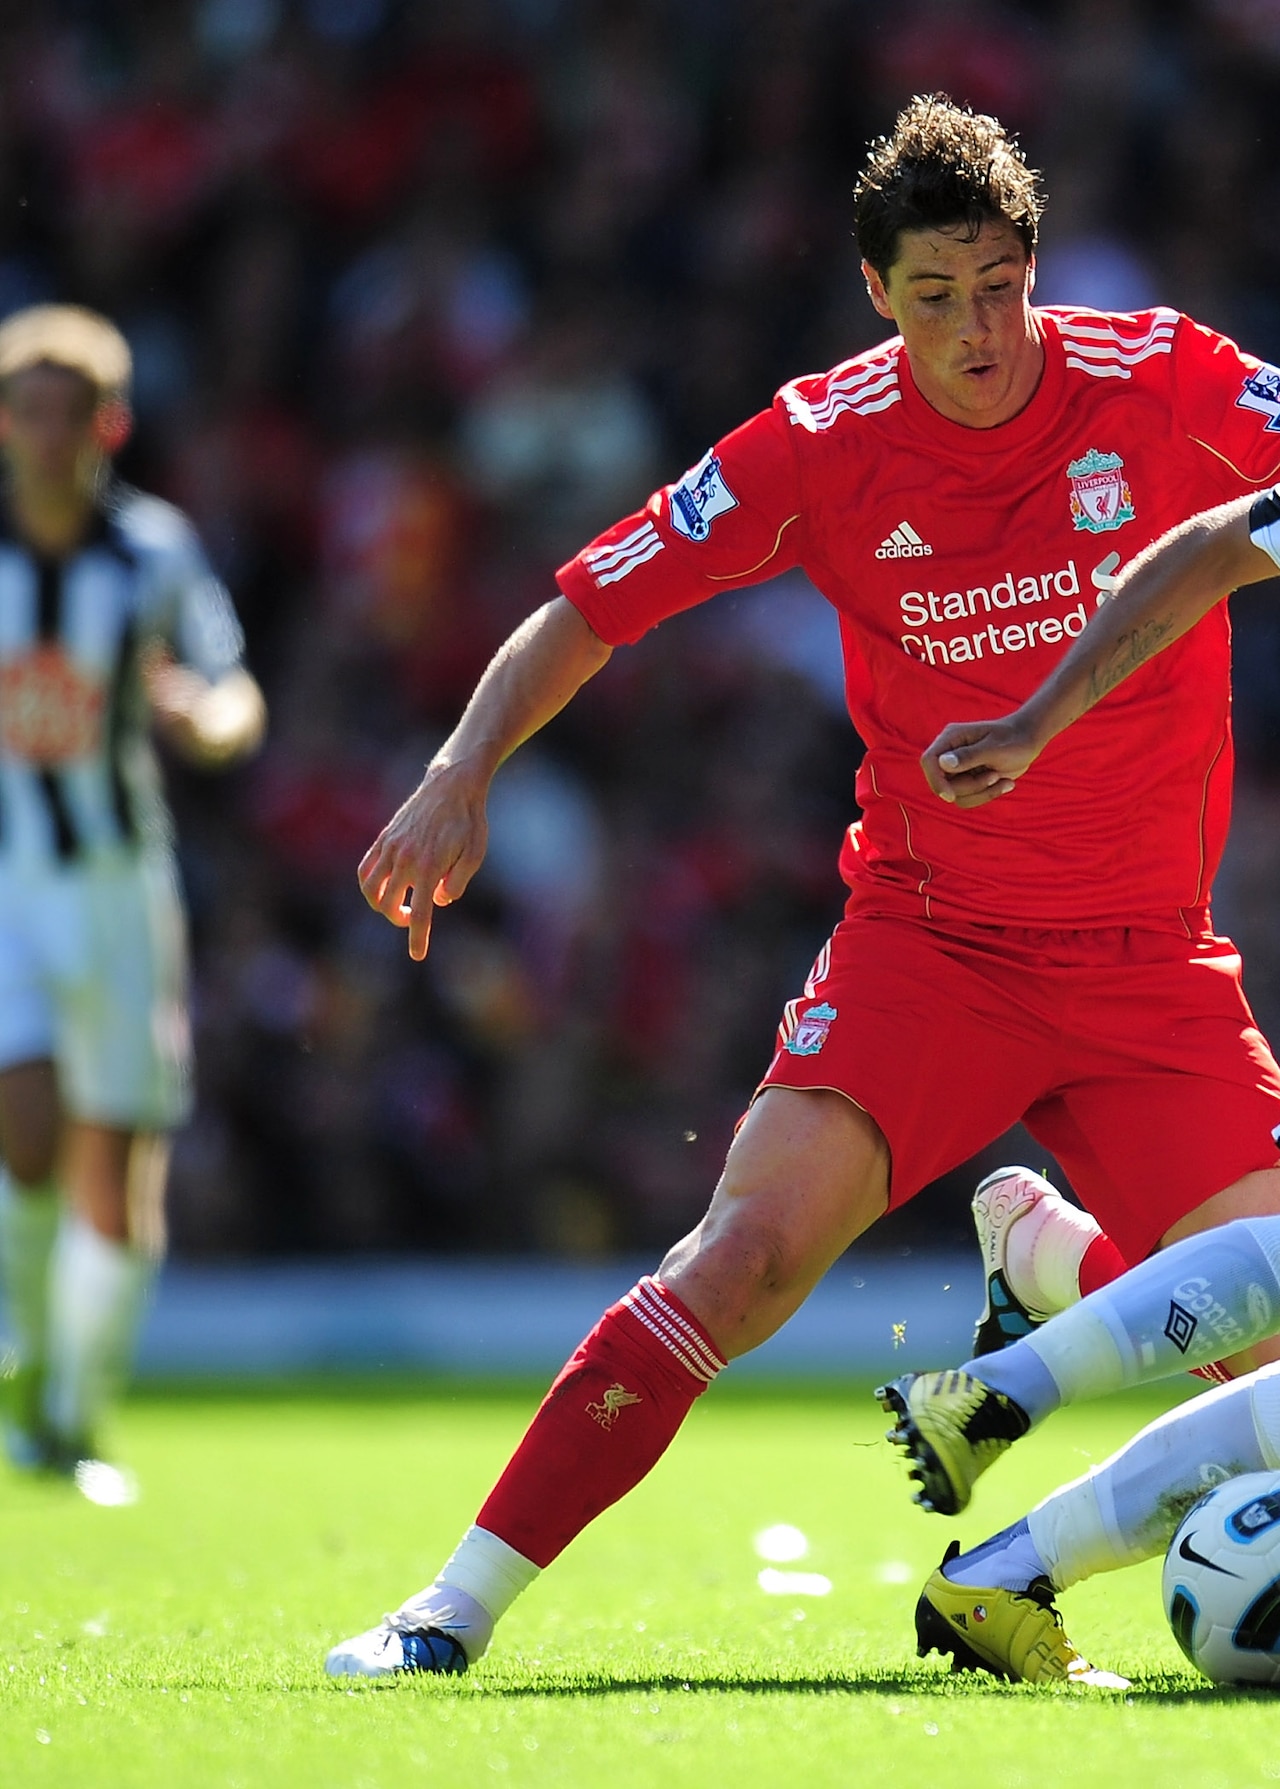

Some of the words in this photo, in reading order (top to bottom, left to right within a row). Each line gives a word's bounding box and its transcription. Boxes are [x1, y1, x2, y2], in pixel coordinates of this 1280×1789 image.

[1077, 475, 1118, 489] LIVERPOOL
[875, 544, 933, 559] adidas
[900, 560, 1080, 627] Standard
[900, 603, 1088, 666] Chartered
